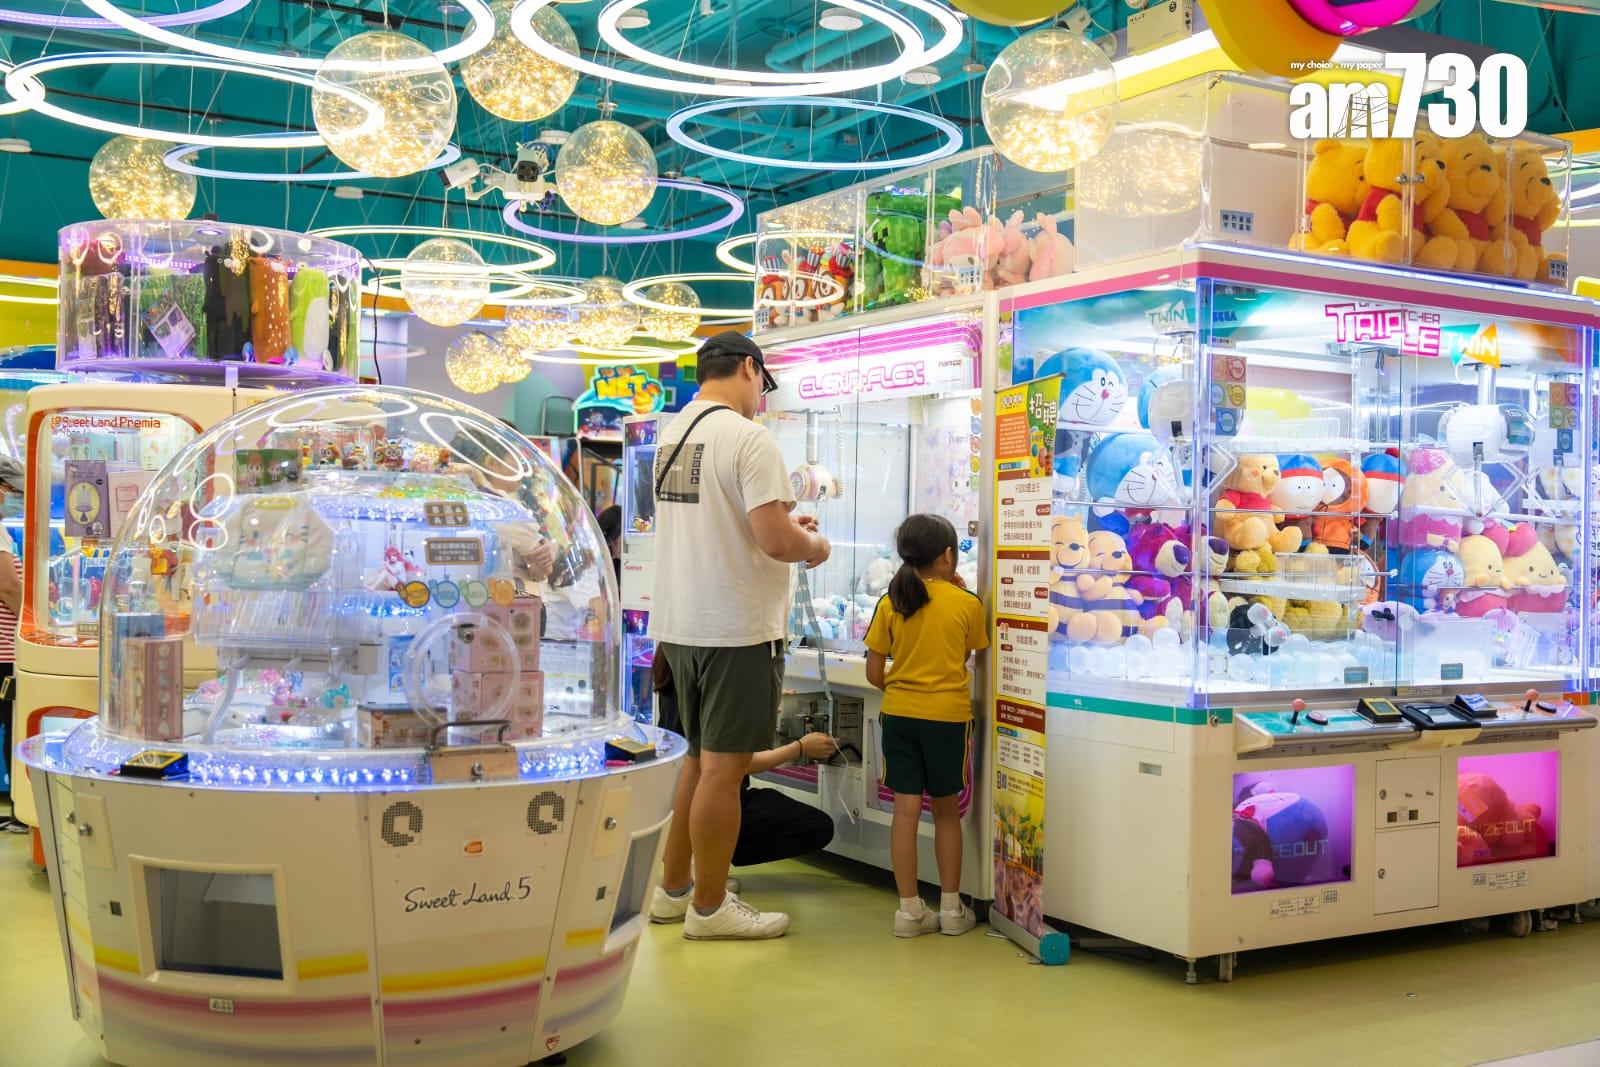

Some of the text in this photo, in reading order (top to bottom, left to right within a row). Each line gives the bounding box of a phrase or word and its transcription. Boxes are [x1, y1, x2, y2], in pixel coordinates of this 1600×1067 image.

[1212, 310, 1238, 322] SEGA
[1446, 333, 1498, 357] TWIN
[938, 359, 962, 368] namco
[596, 374, 646, 400] NET
[91, 416, 118, 428] Land
[119, 416, 161, 429] Premia
[404, 876, 532, 913] Sweet Land 5
